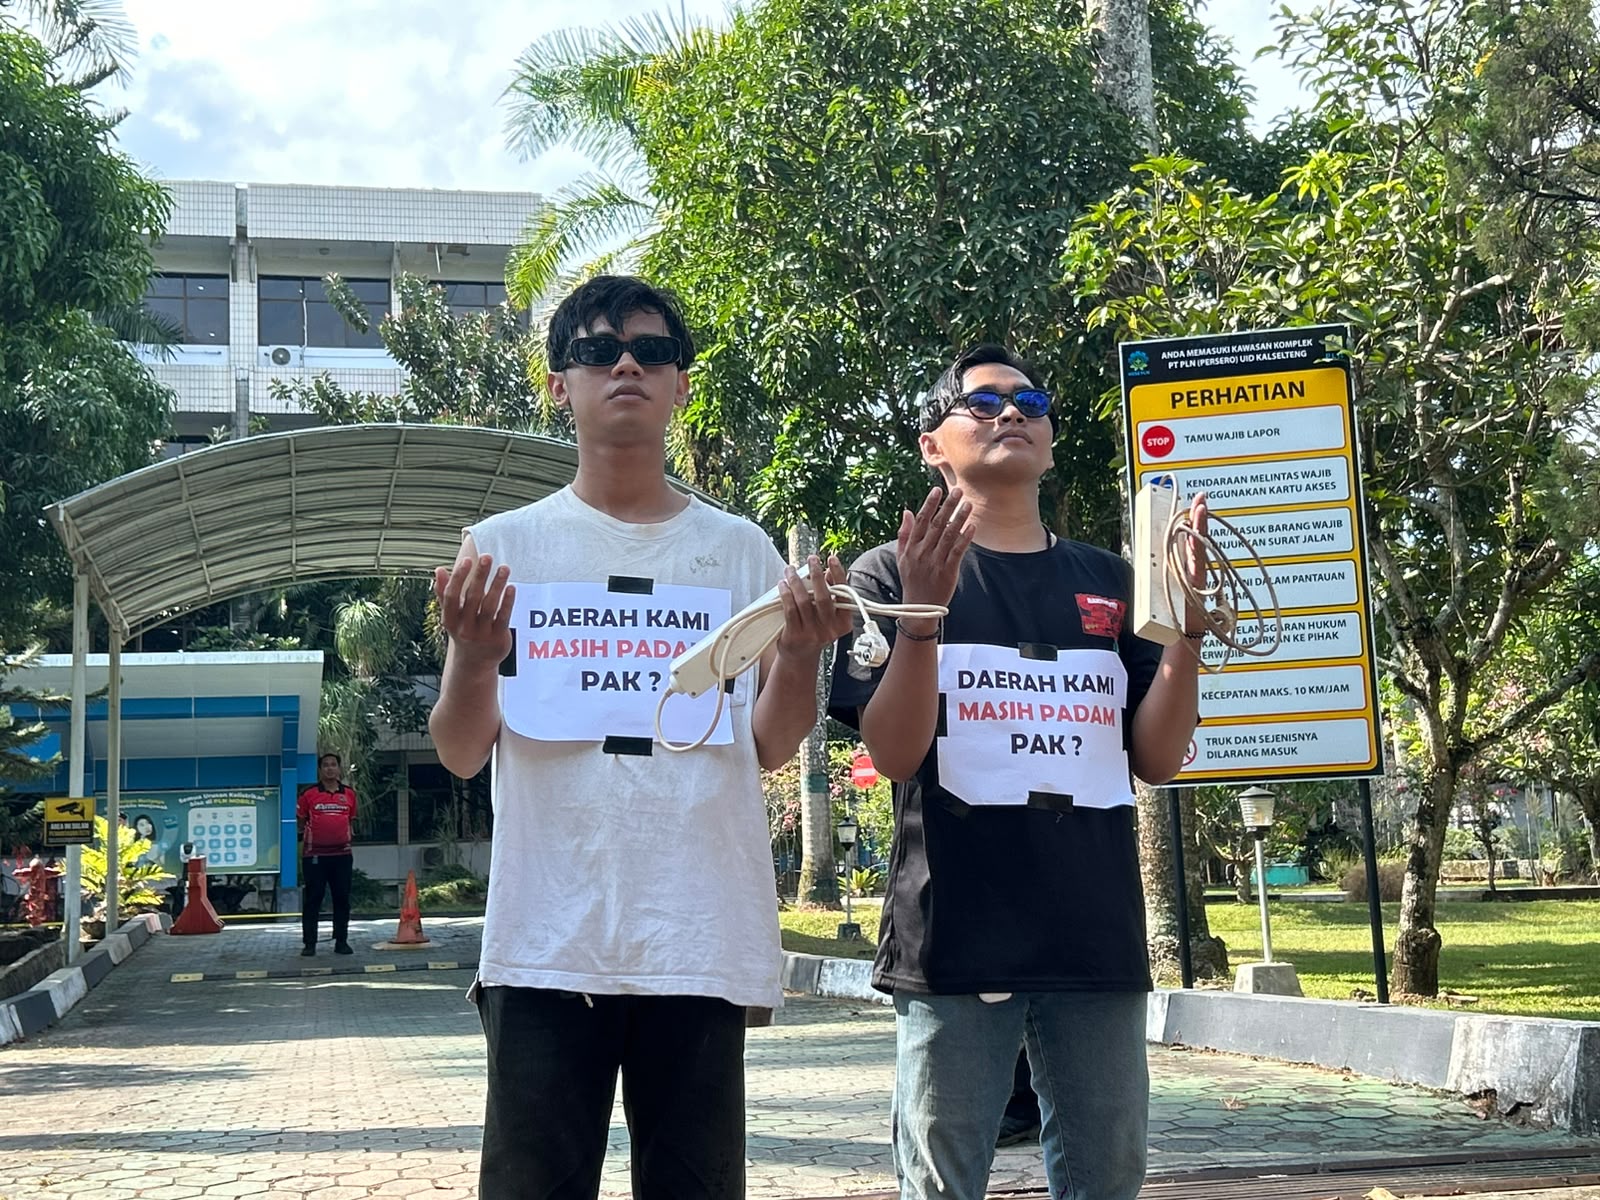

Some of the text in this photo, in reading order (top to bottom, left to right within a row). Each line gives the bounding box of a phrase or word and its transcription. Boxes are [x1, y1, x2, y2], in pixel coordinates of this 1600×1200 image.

[1162, 339, 1313, 359] ANDA MEMASUKI KAWASAN KOMPLEK
[1168, 350, 1307, 369] PT PLN (PERSERO) UID KALSELTENG
[1171, 380, 1304, 409] PERHATIAN
[1147, 438, 1170, 446] STOP
[1184, 428, 1280, 443] TAMU WAJIB LAPOR
[1186, 469, 1332, 488] KENDARAAN MELINTAS WAJIB
[1187, 481, 1336, 500] MGGUNAKAN KARTU AKSES
[1268, 522, 1310, 533] BARANG
[1312, 520, 1343, 530] WAJIB
[1268, 536, 1300, 546] SURAT
[1302, 533, 1335, 543] JALAN
[1292, 572, 1345, 583] PANTAUAN
[530, 608, 709, 631] DAERAH KAMI
[1308, 619, 1346, 629] HUKUM
[1293, 634, 1306, 642] KE
[1308, 631, 1339, 641] PIHAK
[528, 639, 697, 659] MASIH PADA
[582, 671, 662, 692] PAK ?
[958, 670, 1114, 695] DAERAH KAMI
[1202, 684, 1350, 700] KECEPATAN MAKS. 10 KM/JAM
[958, 701, 1115, 727] MASIH PADAM
[1011, 733, 1082, 756] PAK ?
[1205, 732, 1318, 746] TRUK DAN SEJENISNYA
[1207, 747, 1298, 759] DILARANG MASUK
